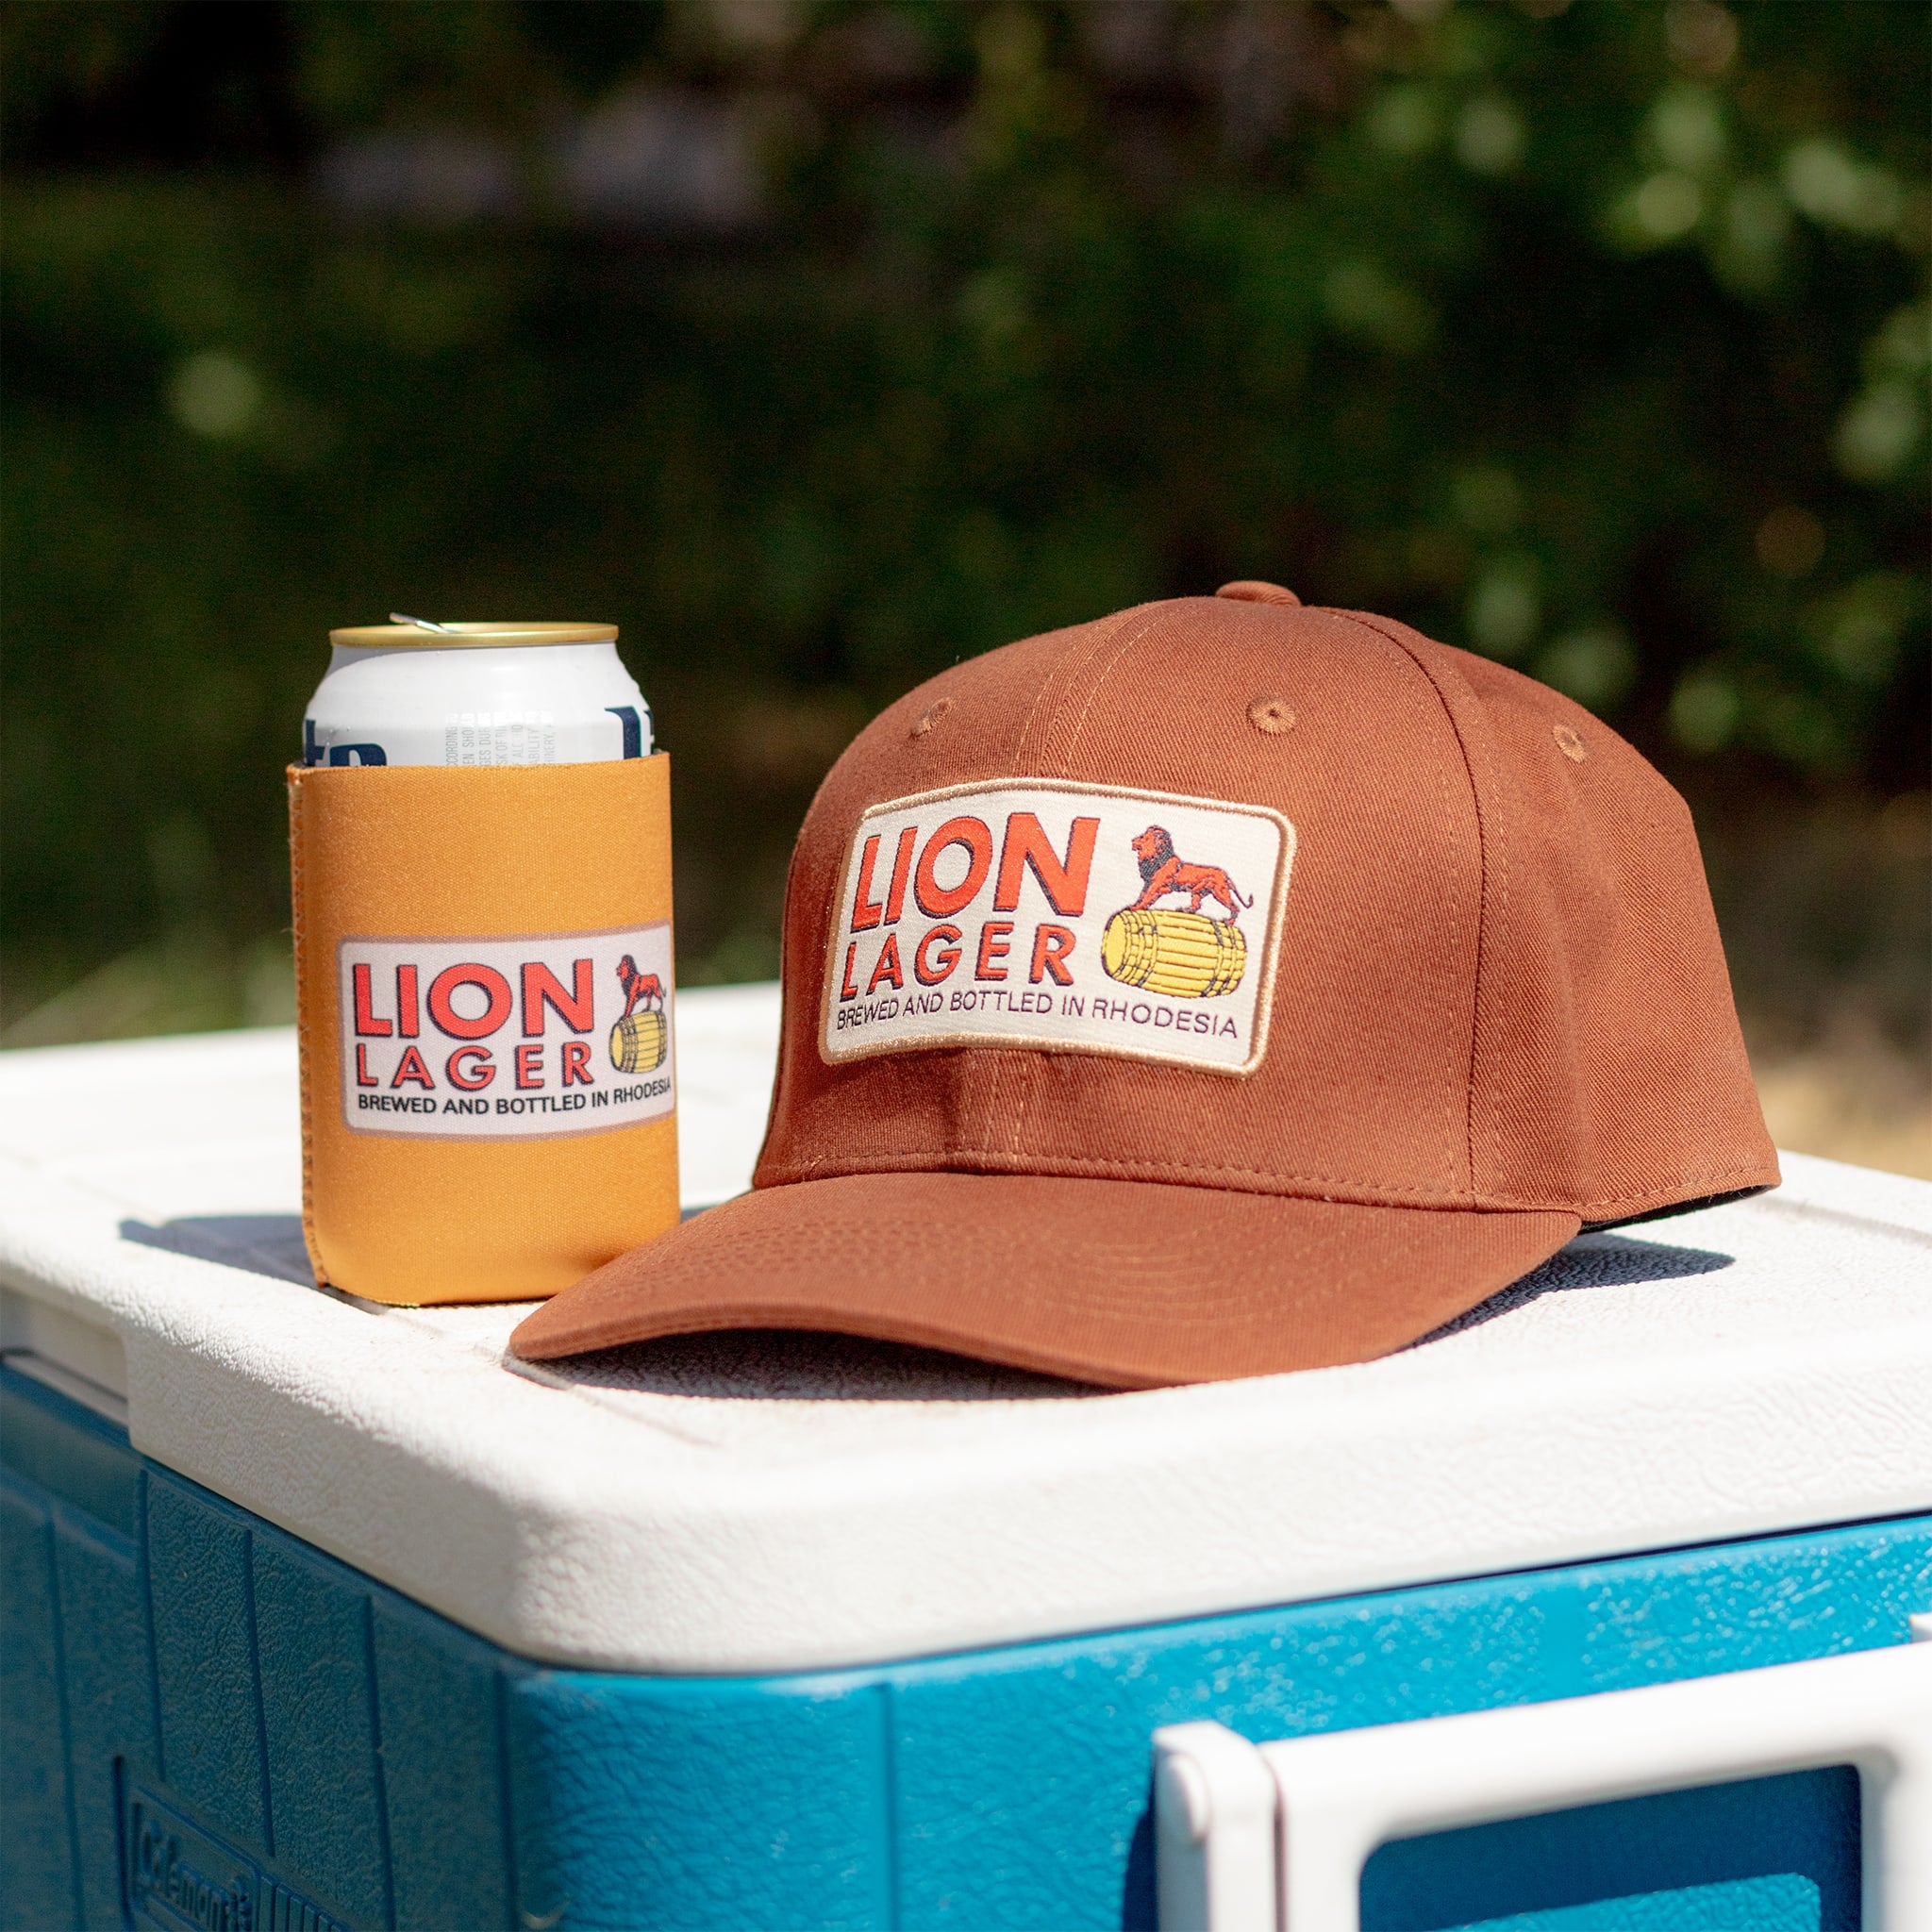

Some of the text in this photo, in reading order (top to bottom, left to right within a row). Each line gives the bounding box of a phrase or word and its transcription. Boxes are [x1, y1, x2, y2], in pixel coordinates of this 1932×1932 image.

[850, 811, 1101, 934] LION
[839, 921, 1077, 1002] LAGER
[352, 958, 594, 1041] LION
[837, 990, 1238, 1040] BREWED AND BOTTLED IN RHODESIA
[356, 1041, 595, 1092] LAGER
[358, 1077, 672, 1115] BREWED AND BOTTLED IN RHODESIA
